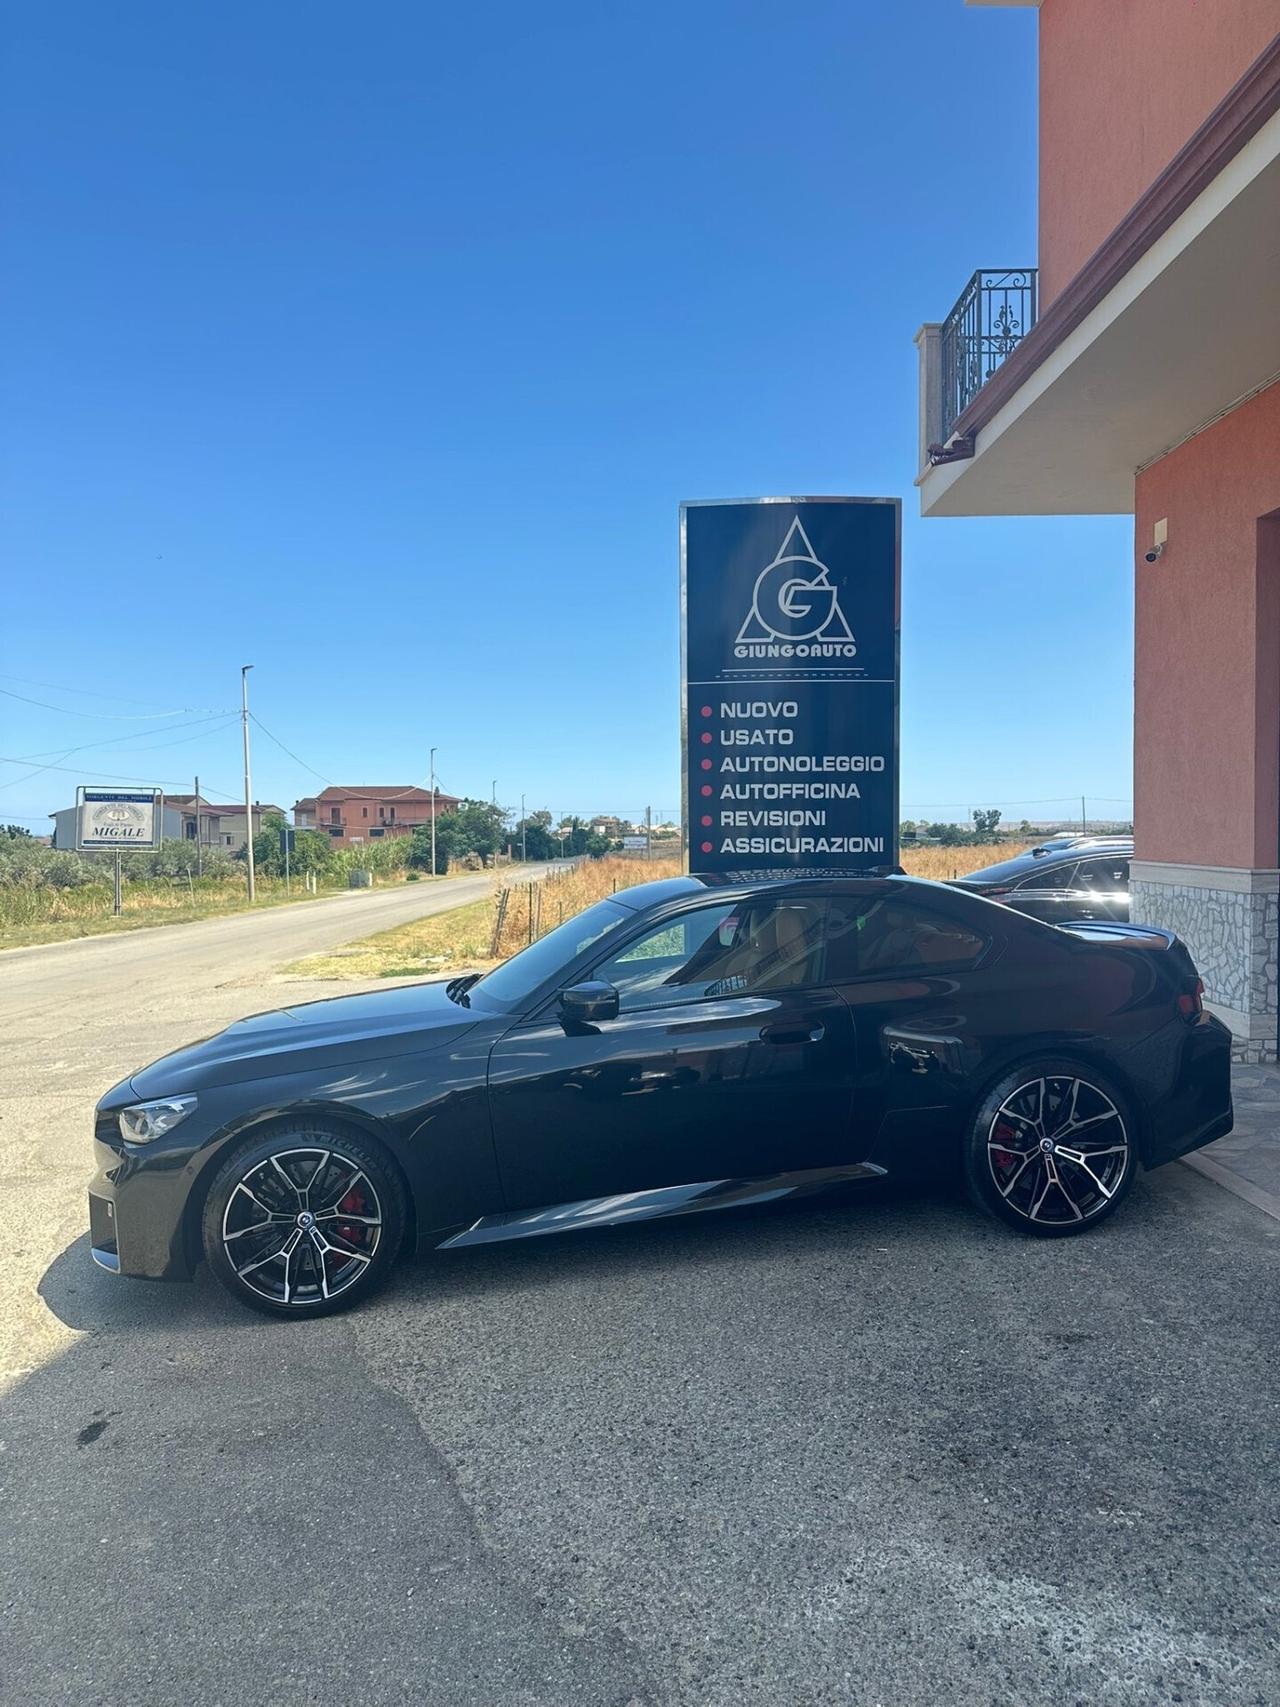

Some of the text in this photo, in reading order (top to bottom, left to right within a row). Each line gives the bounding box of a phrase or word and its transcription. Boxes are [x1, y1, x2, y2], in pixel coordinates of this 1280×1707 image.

[733, 644, 857, 658] GIUNGOAUTO
[720, 701, 799, 718] NUOVO
[720, 729, 794, 746] USATO
[719, 756, 885, 773] AUTONOLEGGIO
[719, 783, 861, 800] AUTOFFICINA
[720, 810, 826, 827] REVISIONI
[92, 827, 145, 837] MIGALE
[719, 837, 884, 854] ASSICURAZIONI
